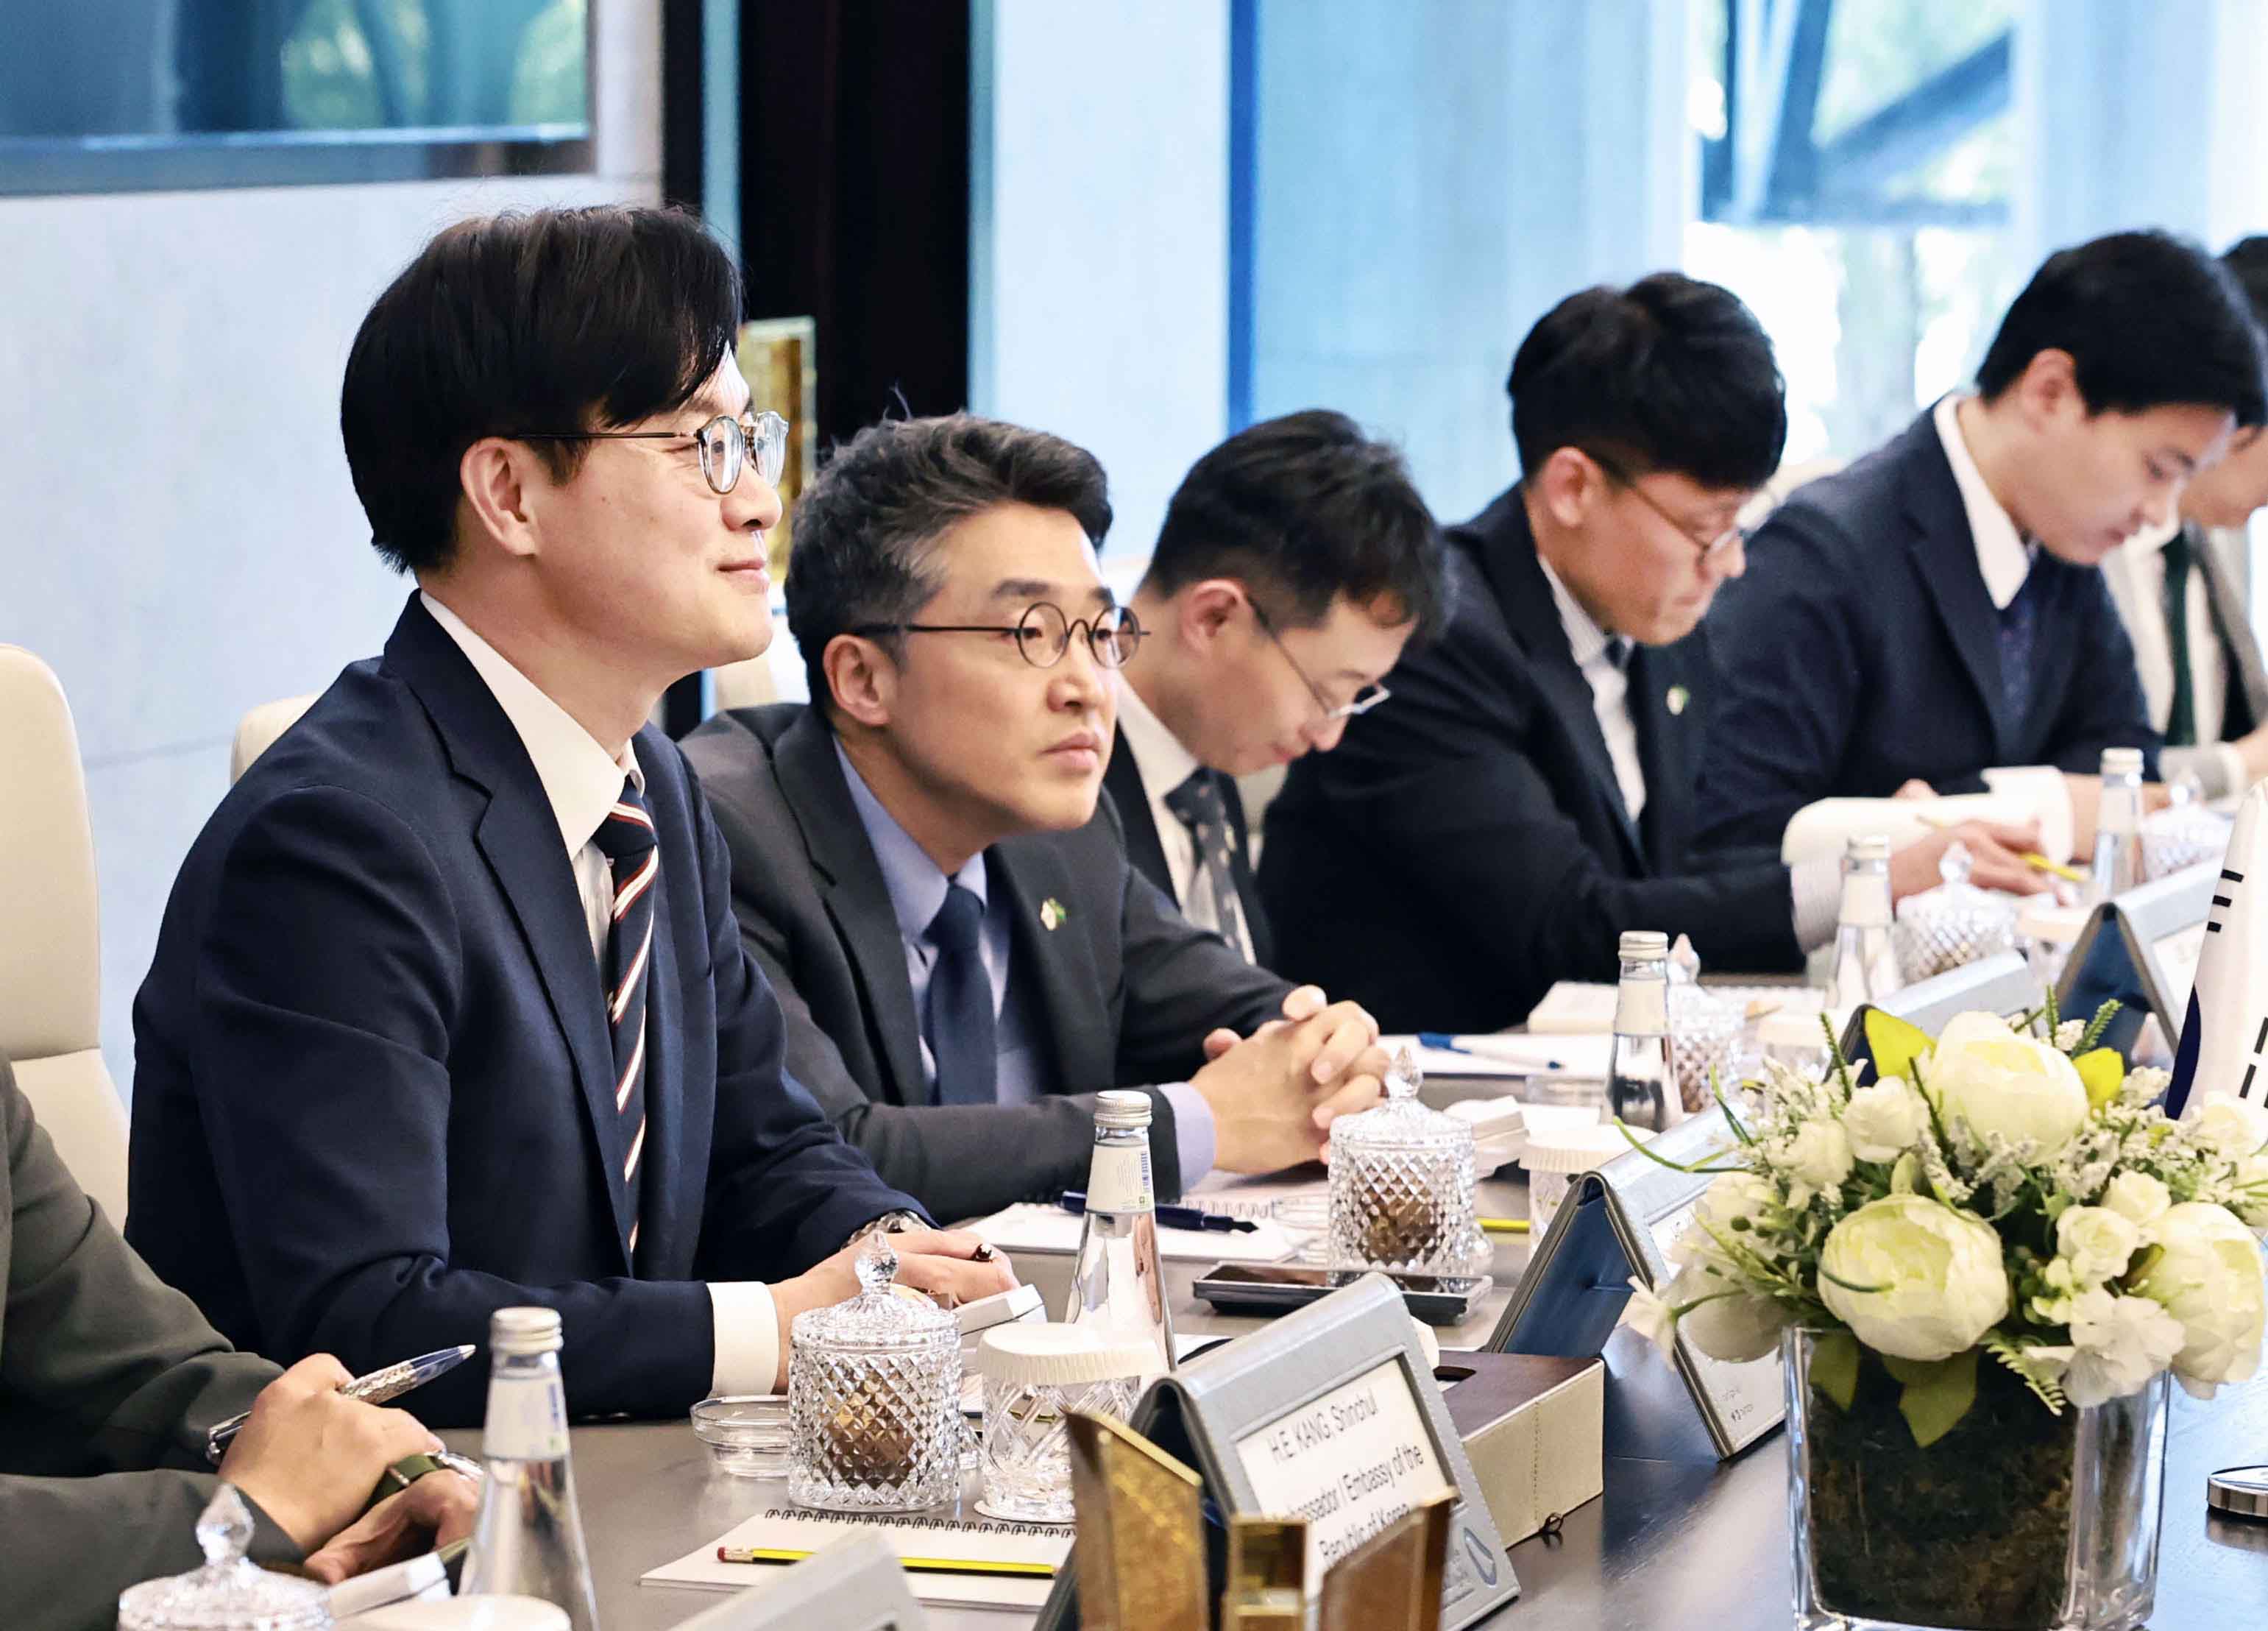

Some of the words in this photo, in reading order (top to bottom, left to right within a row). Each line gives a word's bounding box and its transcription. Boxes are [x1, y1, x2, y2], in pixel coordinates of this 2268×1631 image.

[1342, 1461, 1396, 1501] Embassy
[1392, 1446, 1407, 1476] of
[1401, 1443, 1424, 1470] the
